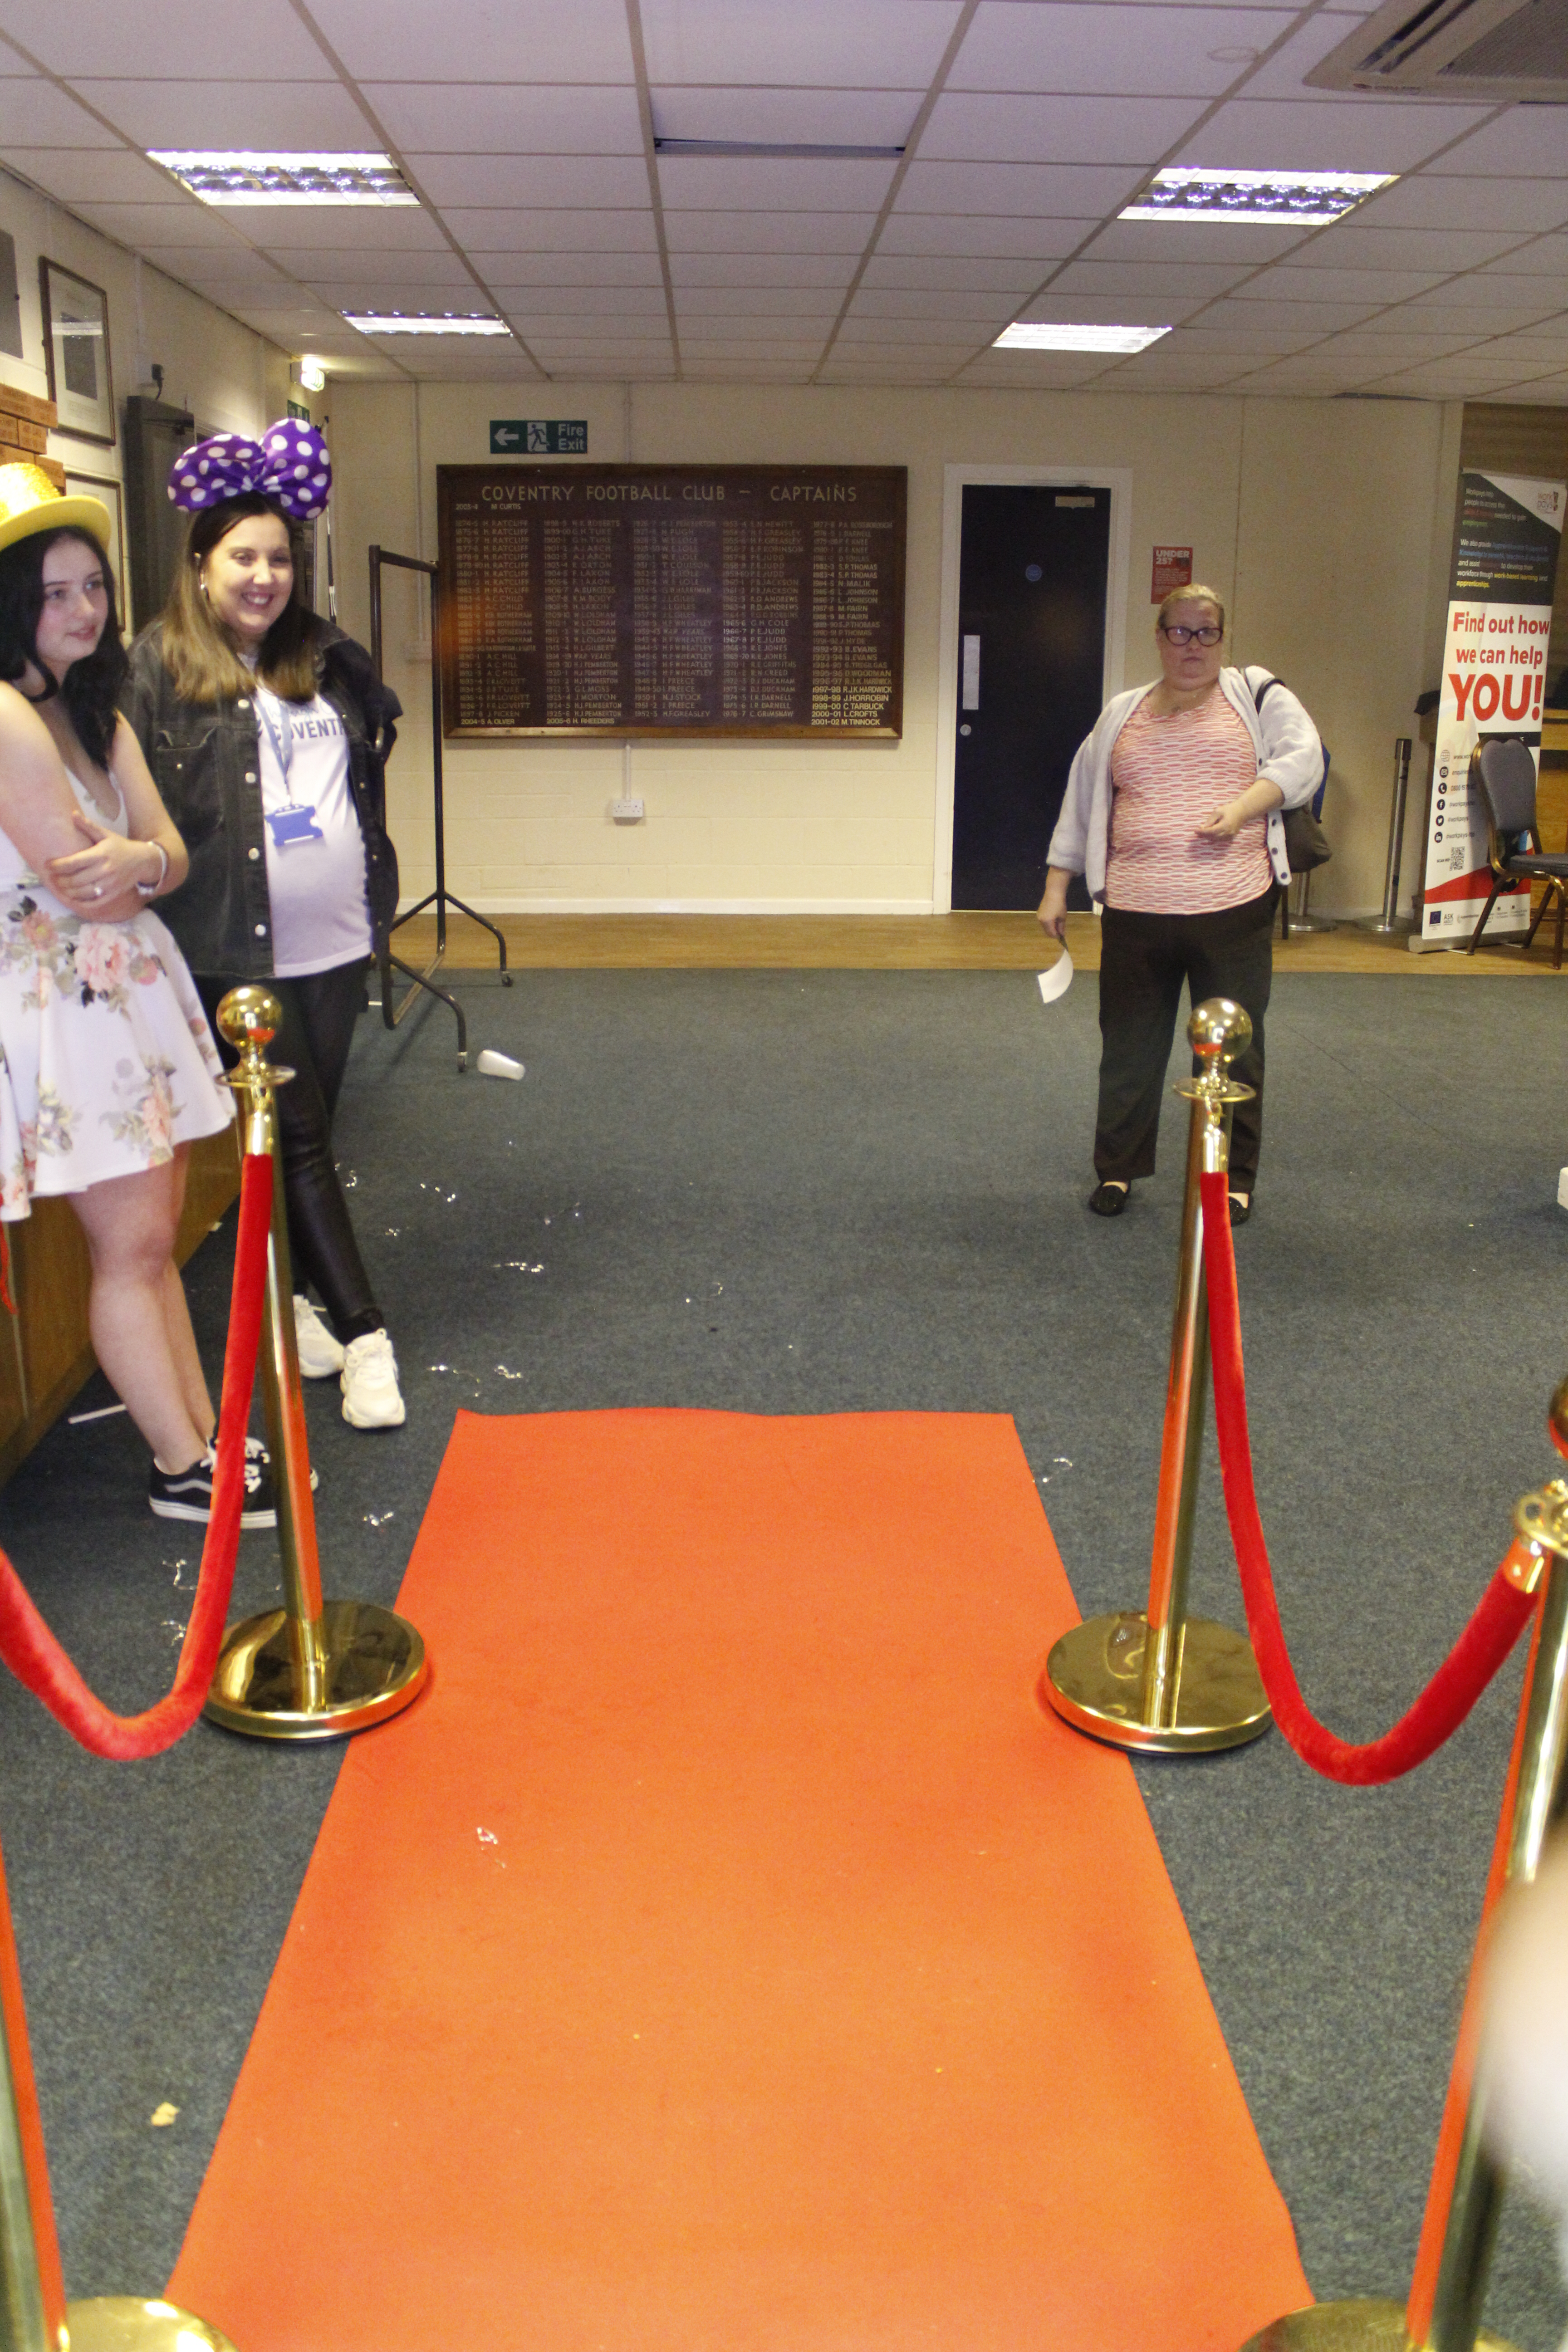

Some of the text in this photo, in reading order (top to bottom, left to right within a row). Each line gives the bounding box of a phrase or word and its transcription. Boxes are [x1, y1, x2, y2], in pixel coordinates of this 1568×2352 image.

[558, 423, 584, 436] Fire
[558, 438, 584, 451] Exit
[482, 485, 858, 502] COVENTRY FOOTBALL CLUB CAPTAINS
[1156, 549, 1190, 558] UNDER
[1480, 571, 1494, 579] through
[1520, 573, 1538, 582] learning
[1453, 611, 1550, 635] Find out how
[1456, 645, 1543, 670] we can help
[1448, 673, 1543, 721] YOU!
